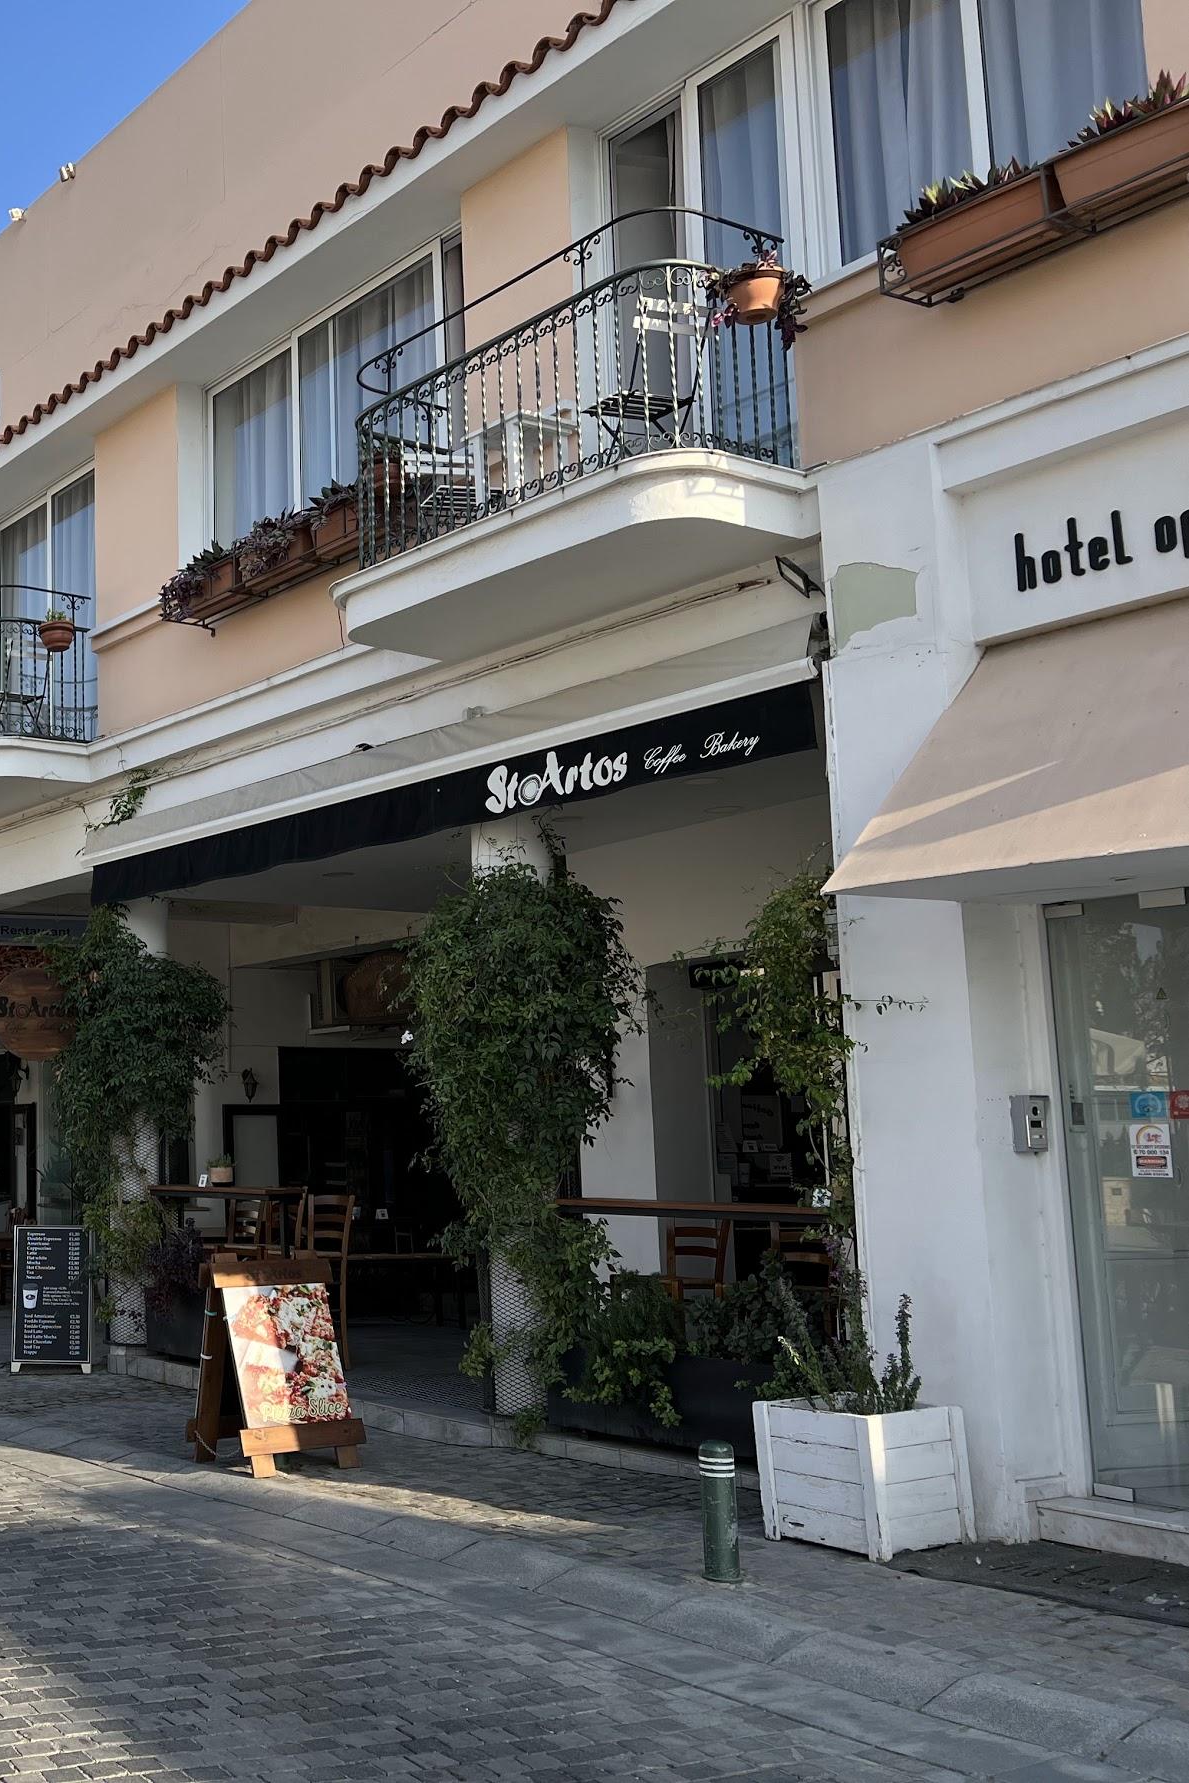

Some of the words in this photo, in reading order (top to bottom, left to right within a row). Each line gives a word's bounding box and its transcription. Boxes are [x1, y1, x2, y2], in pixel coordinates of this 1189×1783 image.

[1014, 509, 1133, 592] hotel
[643, 744, 687, 775] Coffee
[699, 731, 760, 759] Bakery
[308, 1399, 344, 1417] Slice
